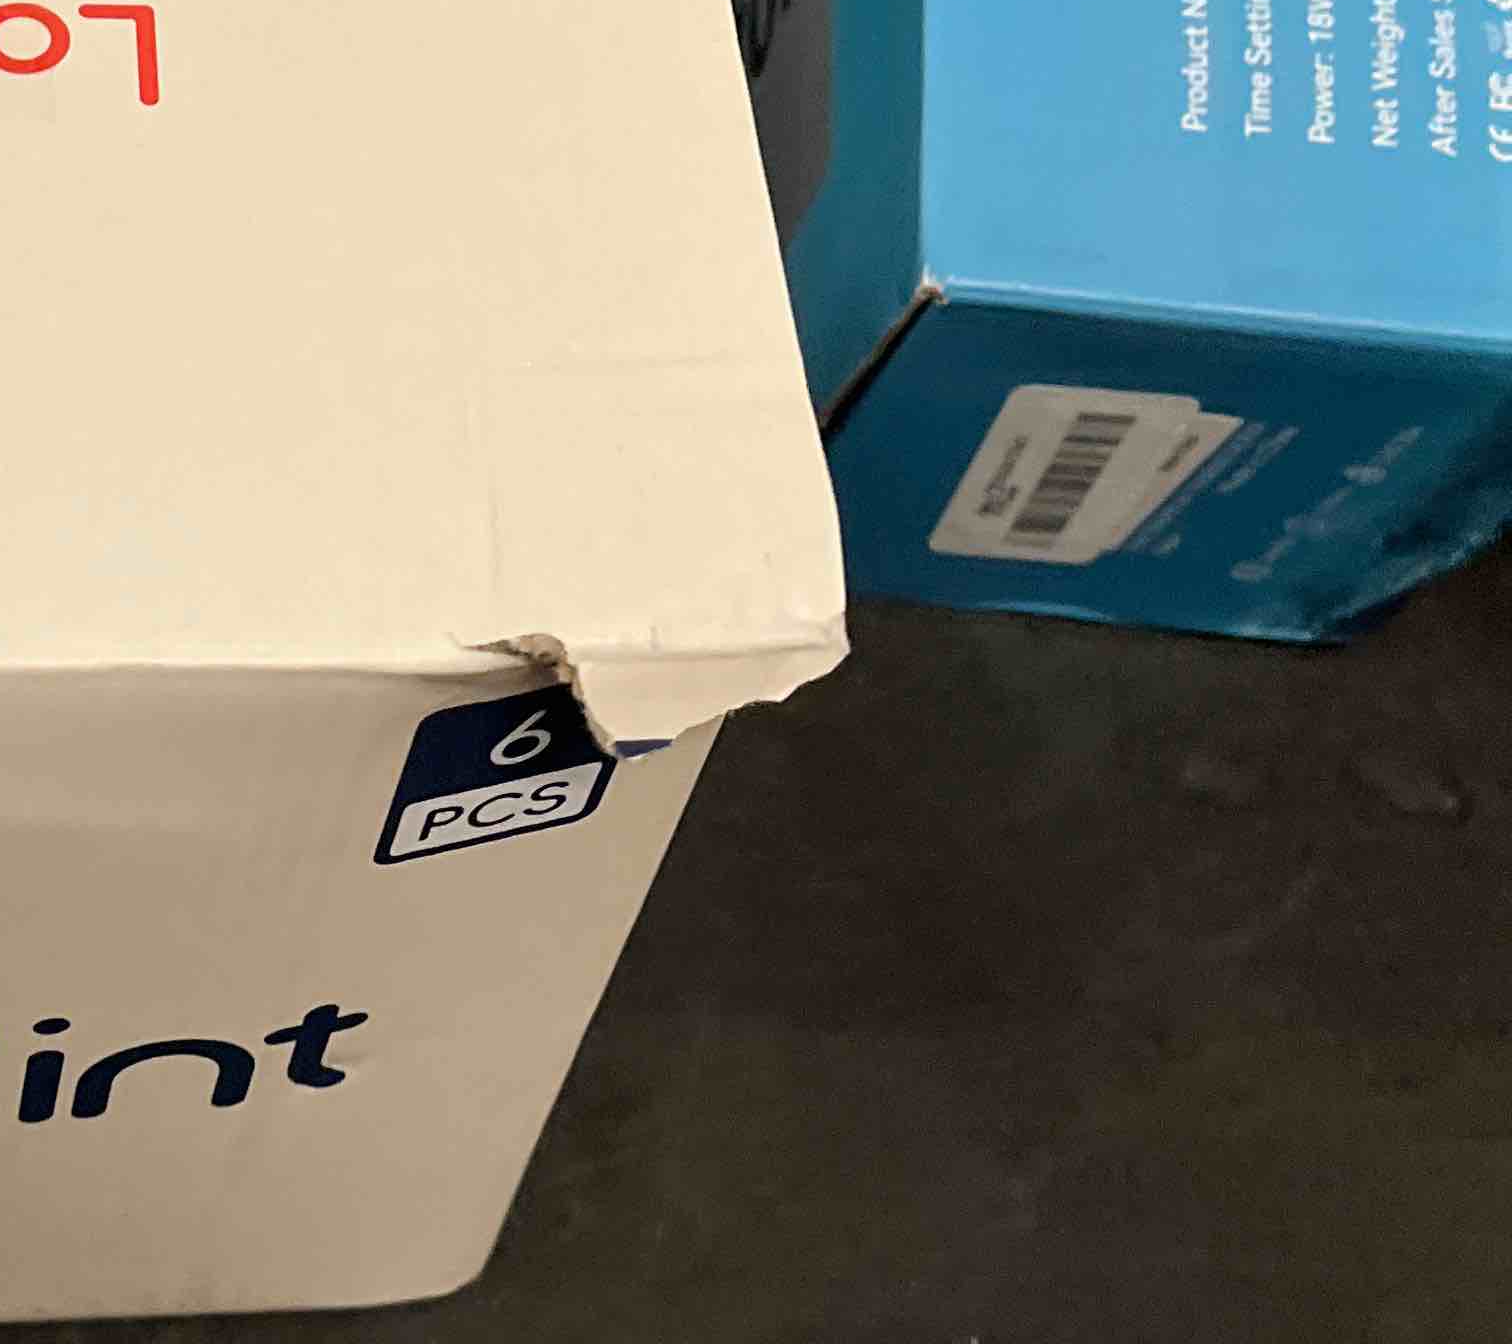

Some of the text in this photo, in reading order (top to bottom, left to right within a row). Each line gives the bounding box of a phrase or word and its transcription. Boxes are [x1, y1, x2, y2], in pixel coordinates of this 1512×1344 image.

[1181, 24, 1209, 133] Product
[1428, 8, 1457, 81] Sales
[1244, 71, 1273, 139] Time
[1306, 51, 1336, 145] Power:
[1372, 97, 1400, 149] Net
[1428, 83, 1458, 158] After
[489, 709, 552, 766] 6
[417, 780, 572, 842] PCS
